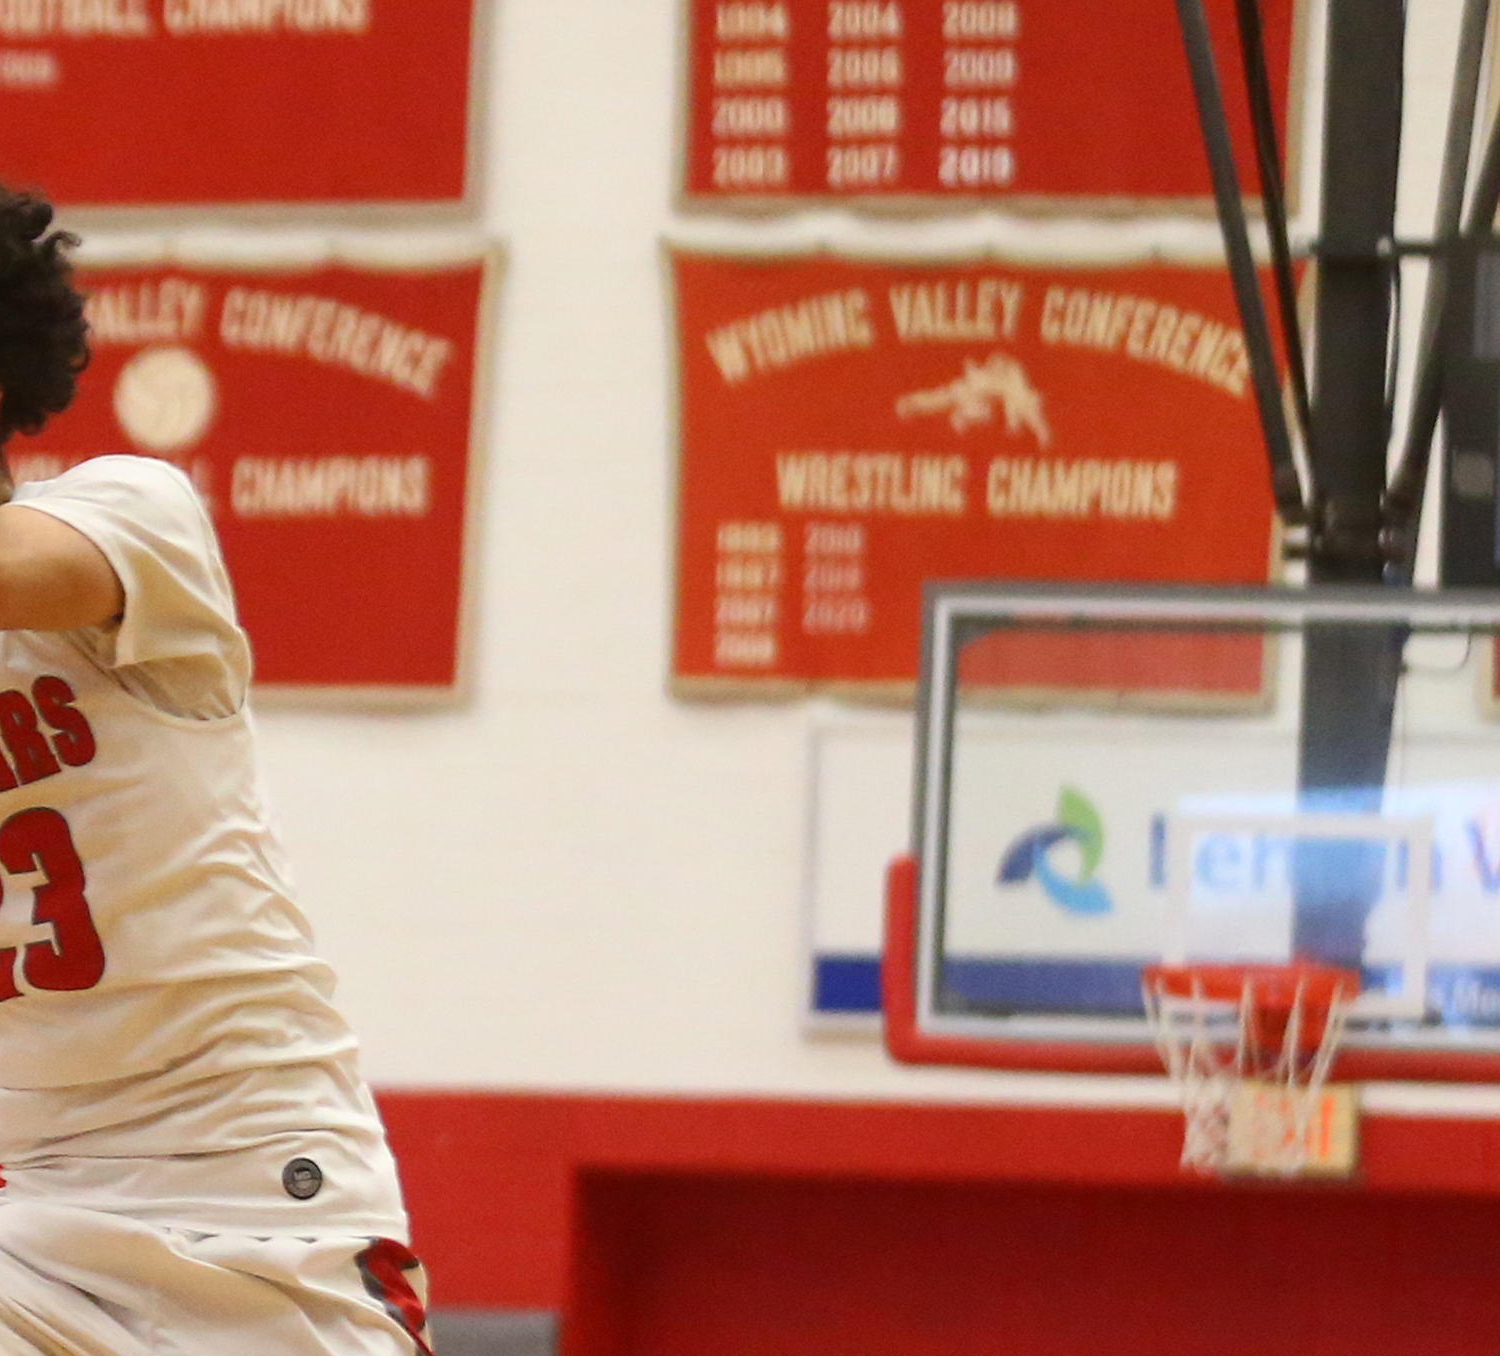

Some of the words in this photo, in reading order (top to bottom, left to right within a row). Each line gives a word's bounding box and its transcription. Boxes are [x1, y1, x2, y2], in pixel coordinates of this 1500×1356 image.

[83, 277, 204, 343] ALLEY
[220, 287, 452, 396] CONFERENCE
[706, 289, 874, 384] WYOMING
[889, 278, 1022, 344] VALLEY
[231, 455, 428, 517] CHAMPIONS
[776, 452, 966, 514] WRESTLING
[987, 457, 1177, 520] CHAMPIONS
